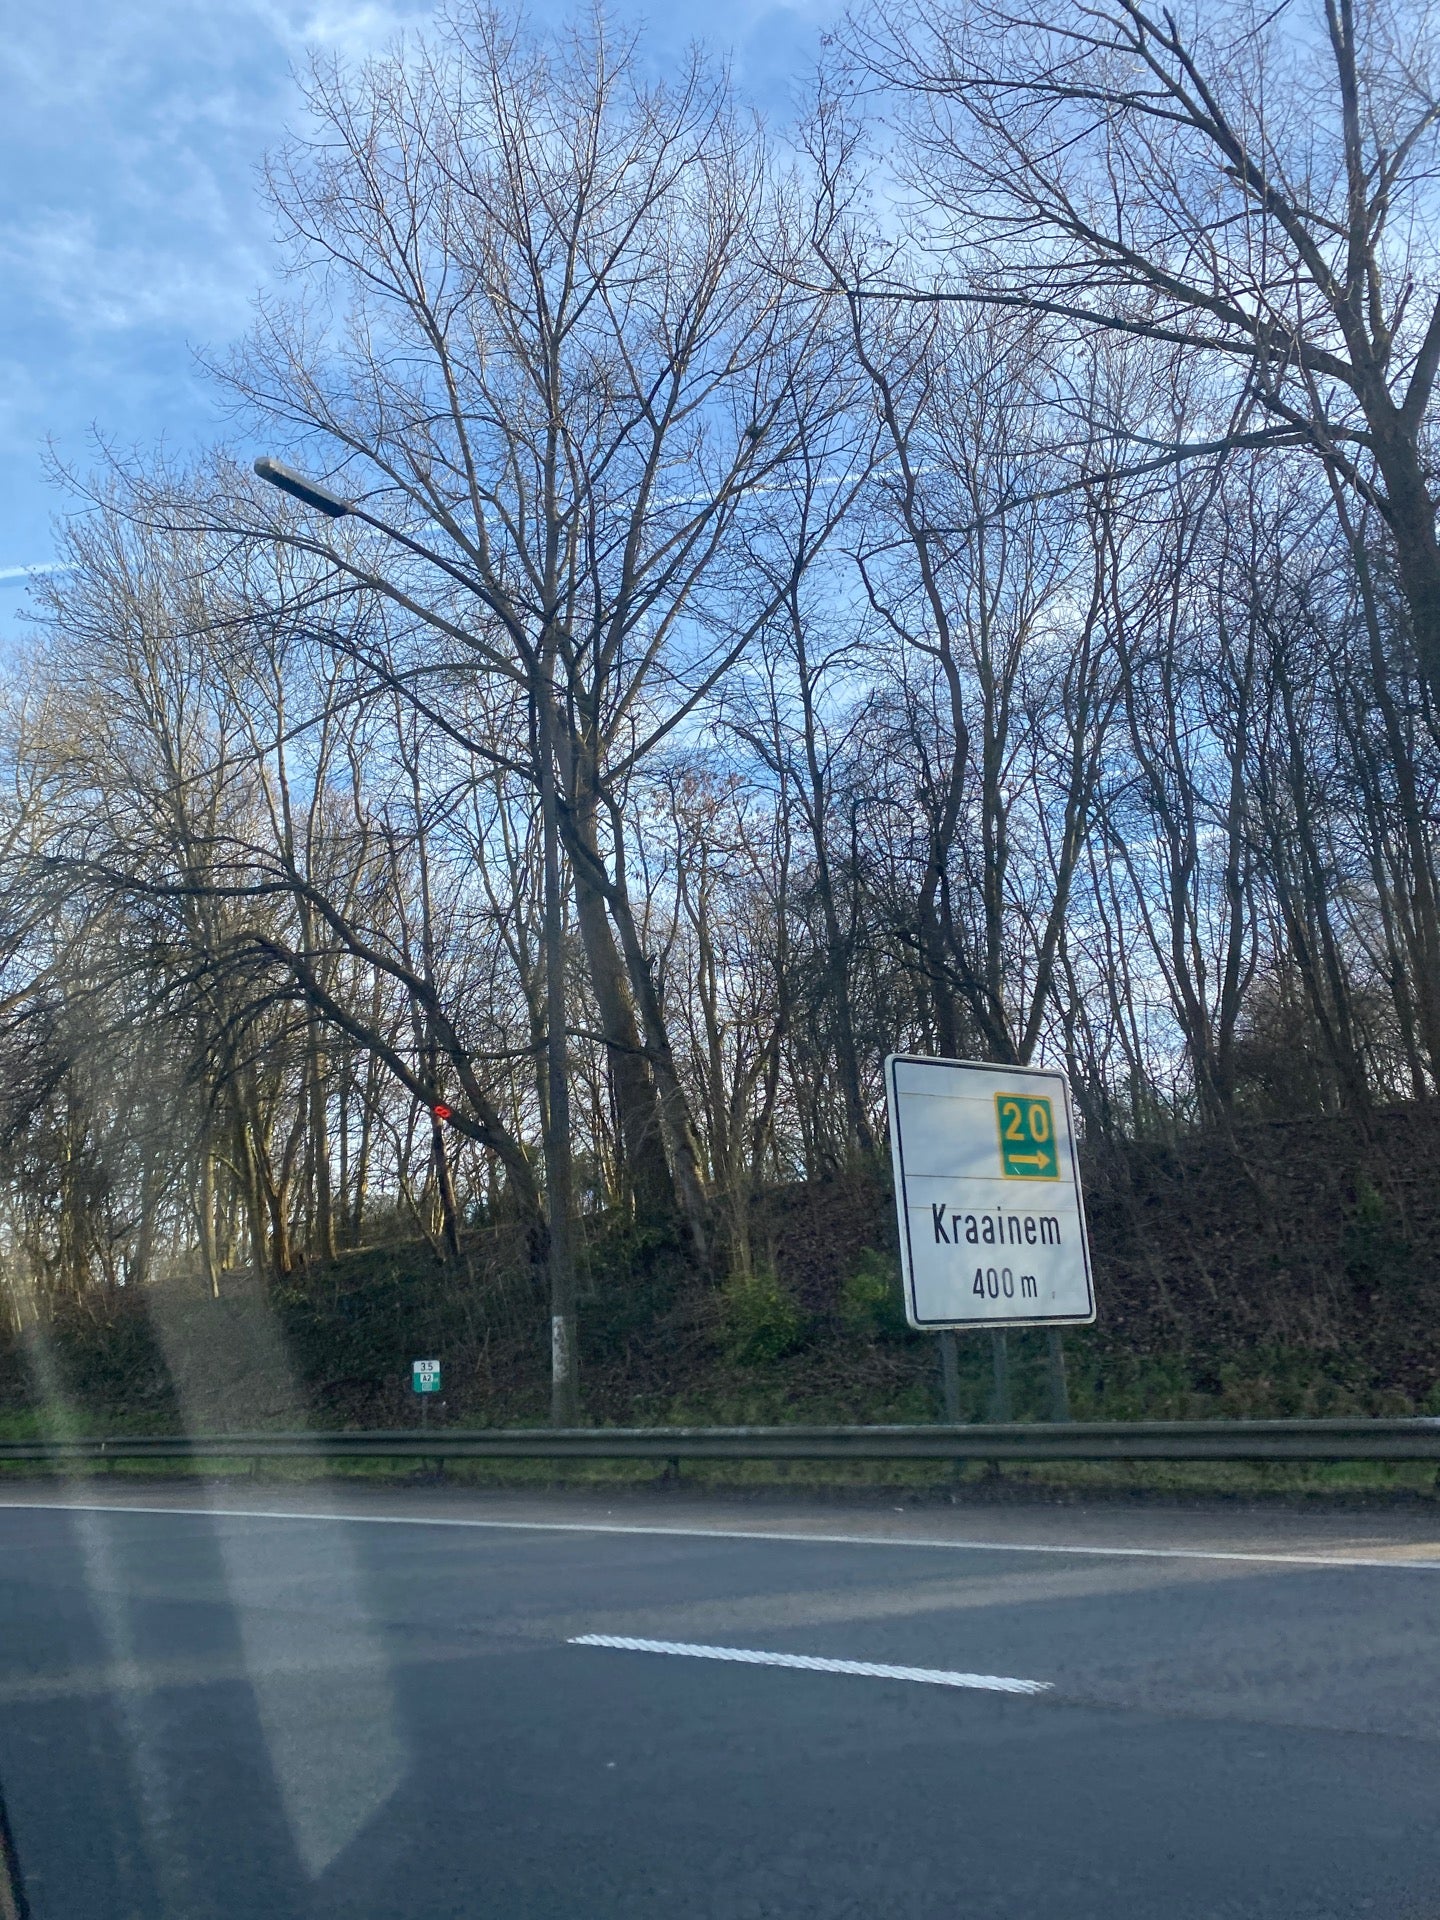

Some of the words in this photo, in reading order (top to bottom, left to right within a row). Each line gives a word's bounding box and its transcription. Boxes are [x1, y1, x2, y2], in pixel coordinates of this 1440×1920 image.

[1002, 1101, 1049, 1143] 20
[931, 1203, 1062, 1245] Kraainem
[972, 1267, 1015, 1299] 400
[1021, 1274, 1038, 1298] m
